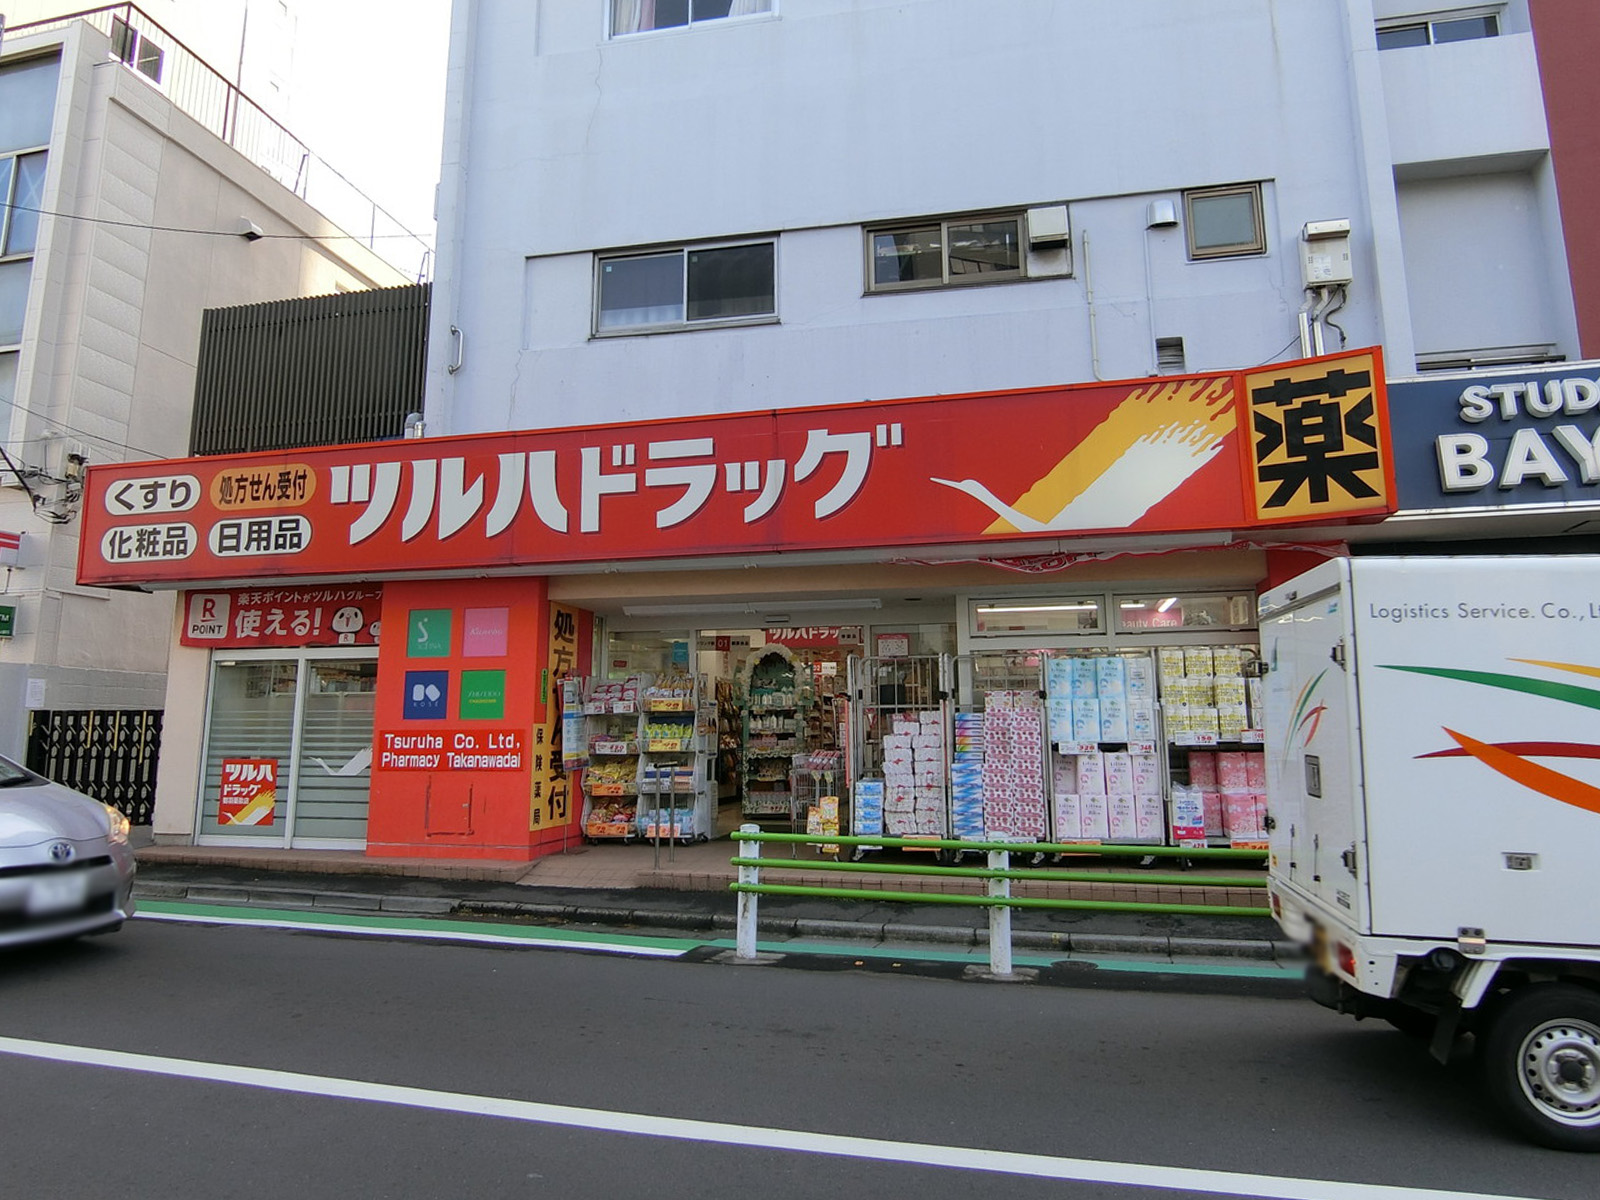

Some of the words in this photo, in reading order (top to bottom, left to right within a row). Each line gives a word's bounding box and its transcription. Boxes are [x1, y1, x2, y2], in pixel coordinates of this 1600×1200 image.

[1459, 377, 1600, 423] STUD
[1252, 369, 1381, 509] 薬
[114, 479, 192, 510] くすり
[219, 469, 308, 504] 処方せん受付
[330, 423, 902, 546] ツルハドラッグ
[109, 526, 188, 559] 化粧品
[218, 518, 303, 553] 日用品
[202, 599, 216, 618] R
[1370, 603, 1449, 623] Logistics
[1458, 602, 1535, 619] Service.
[1541, 602, 1585, 621] Co.,
[192, 624, 224, 635] POINT
[769, 627, 842, 640] ツルハドラッ
[1152, 617, 1177, 628] Care
[548, 609, 575, 821] 処方受付
[385, 733, 443, 749] Tsuruha
[454, 733, 479, 749] Co.
[225, 764, 273, 782] ツルハ
[381, 752, 440, 768] Pharmacy
[447, 752, 521, 768] Takanawadai
[533, 728, 543, 825] 保険薬局
[223, 784, 262, 796] ドラッグ
